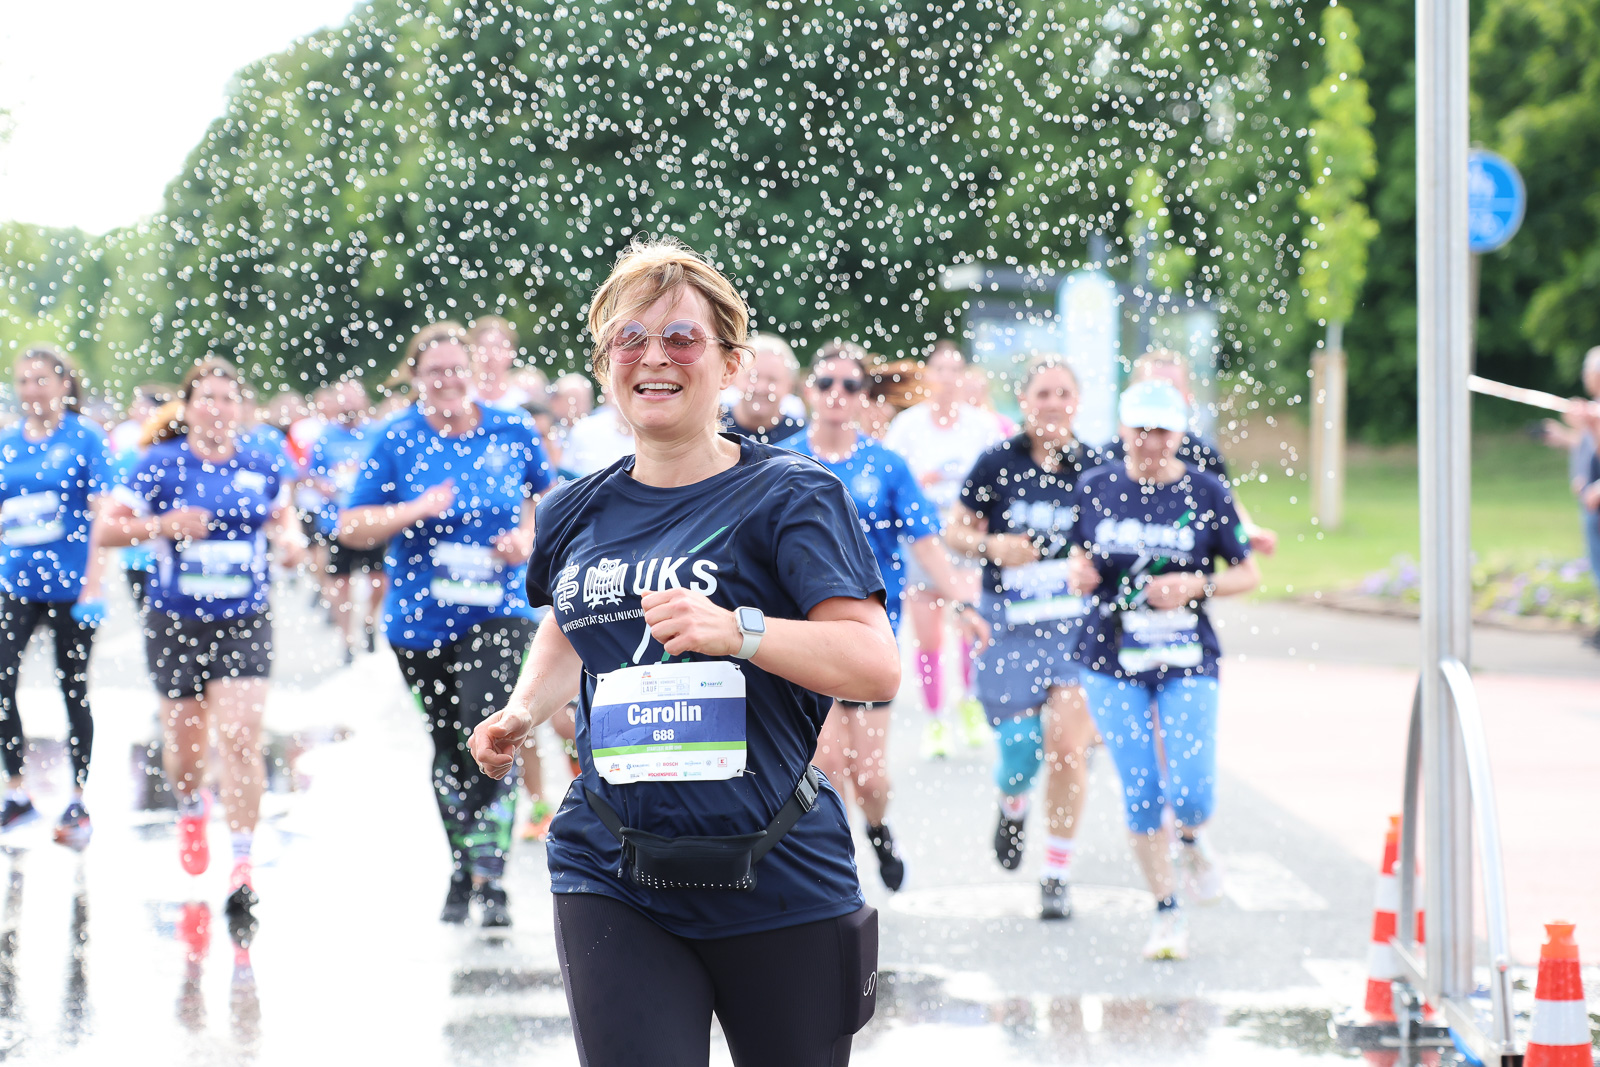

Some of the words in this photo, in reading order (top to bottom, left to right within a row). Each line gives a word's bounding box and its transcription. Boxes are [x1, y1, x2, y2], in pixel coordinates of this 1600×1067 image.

[633, 557, 718, 596] UKS
[627, 701, 702, 725] Carolin
[652, 729, 675, 741] 688
